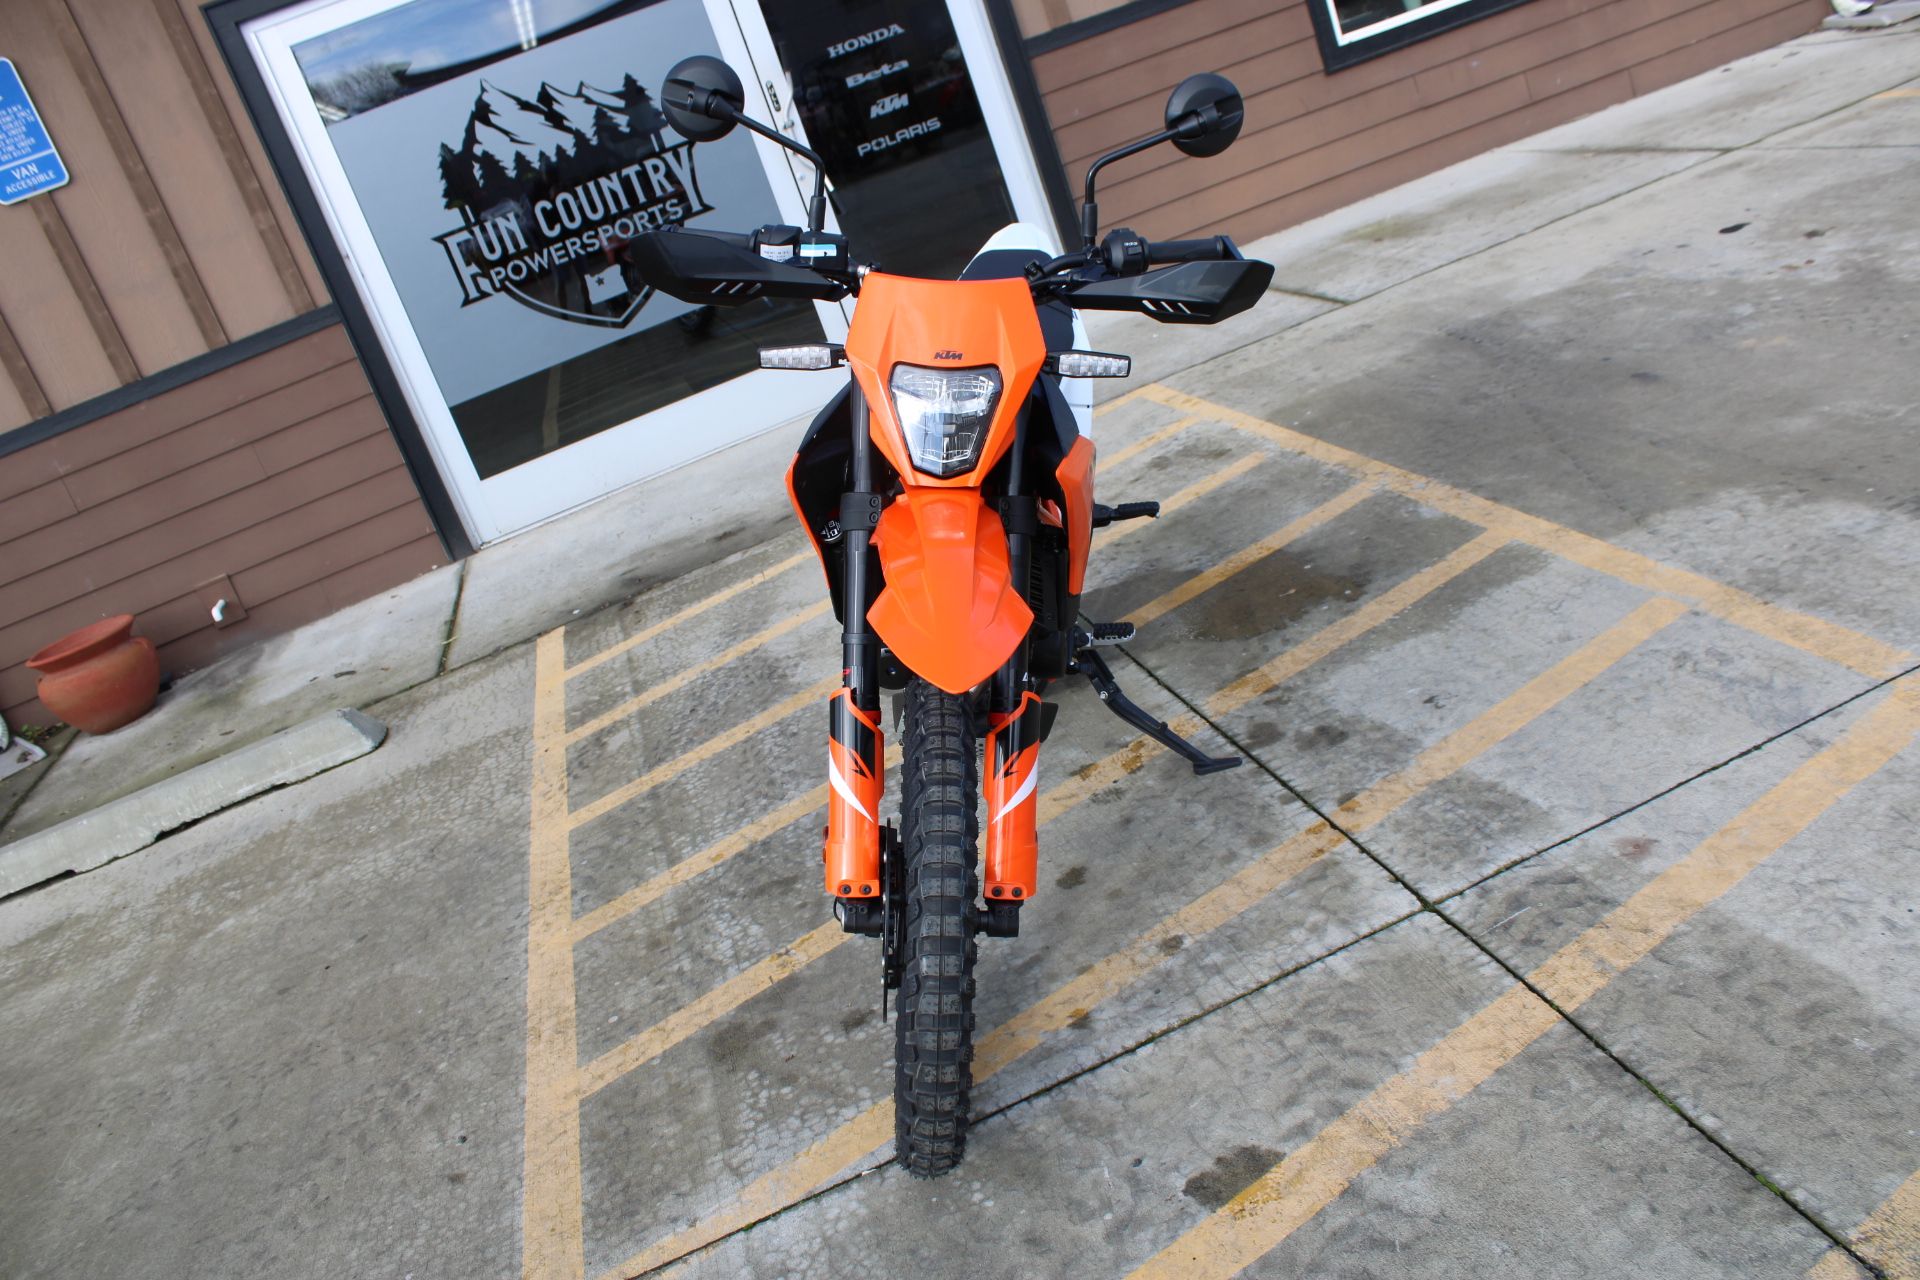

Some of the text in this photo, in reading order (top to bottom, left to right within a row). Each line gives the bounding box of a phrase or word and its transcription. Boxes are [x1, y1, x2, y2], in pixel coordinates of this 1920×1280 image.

[827, 24, 905, 58] HONDA
[846, 60, 909, 89] Beta
[870, 93, 909, 119] KTM
[857, 117, 941, 157] POLARIS
[5, 169, 56, 194] ACCESSIBLE
[11, 163, 38, 180] VAN
[443, 147, 703, 300] FUN COUNTRY
[490, 199, 683, 289] POWERSPORTS
[934, 350, 963, 361] KTM
